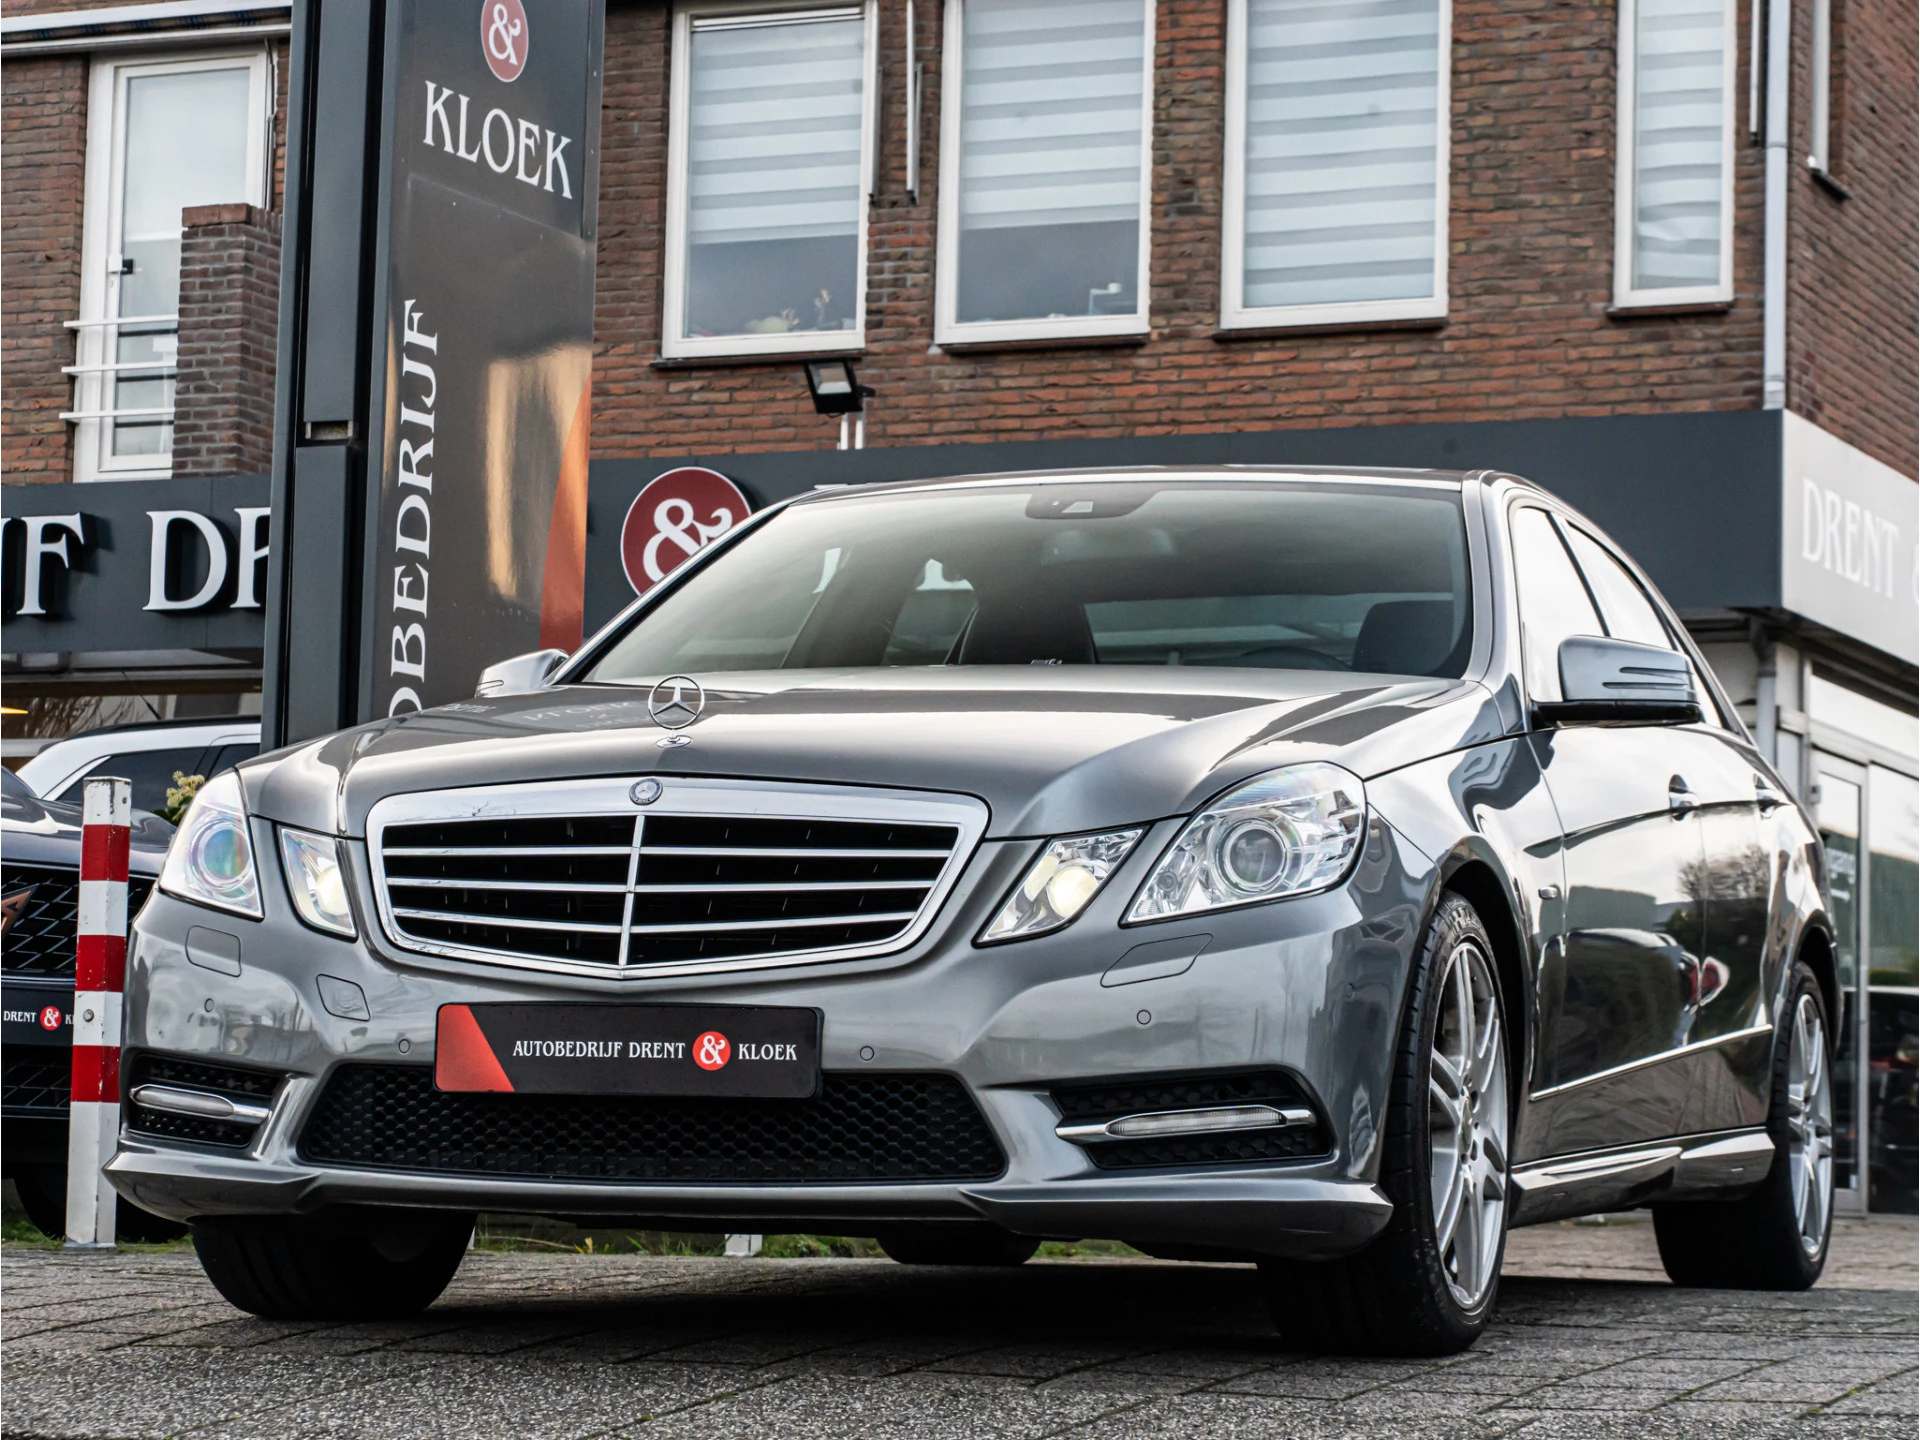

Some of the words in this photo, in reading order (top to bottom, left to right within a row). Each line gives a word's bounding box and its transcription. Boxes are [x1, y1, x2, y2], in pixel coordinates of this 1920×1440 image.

[489, 3, 521, 66] &
[423, 80, 573, 200] KLOEK
[1801, 477, 1900, 600] DRENT
[3, 1010, 36, 1023] DRENT
[44, 1008, 59, 1027] &
[512, 1040, 623, 1059] AUTOBEDRIJF
[628, 1041, 686, 1059] DRENT
[700, 1035, 726, 1065] &
[738, 1043, 797, 1061] KLOEK
